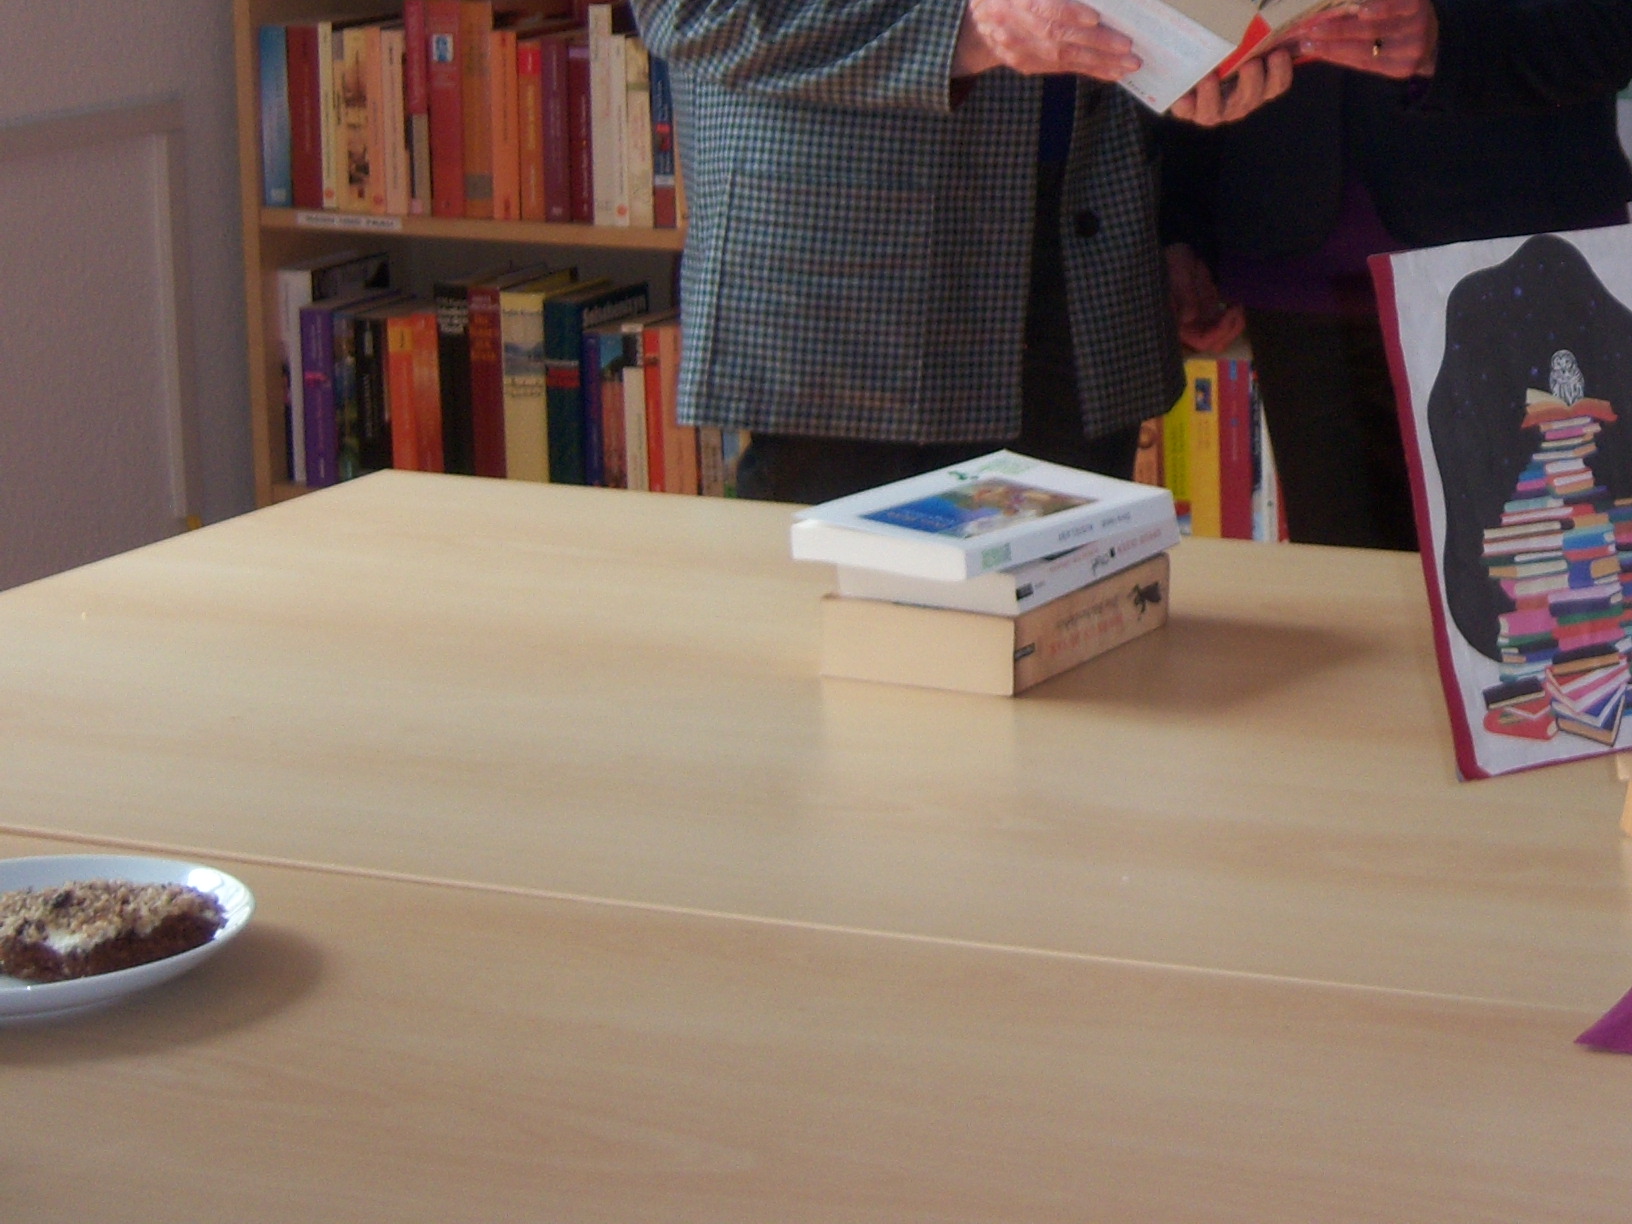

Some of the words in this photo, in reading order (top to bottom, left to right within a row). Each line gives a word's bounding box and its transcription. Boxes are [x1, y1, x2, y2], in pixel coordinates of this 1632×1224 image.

[305, 215, 336, 225] MANN
[342, 216, 363, 226] UND
[368, 217, 394, 228] FRAU
